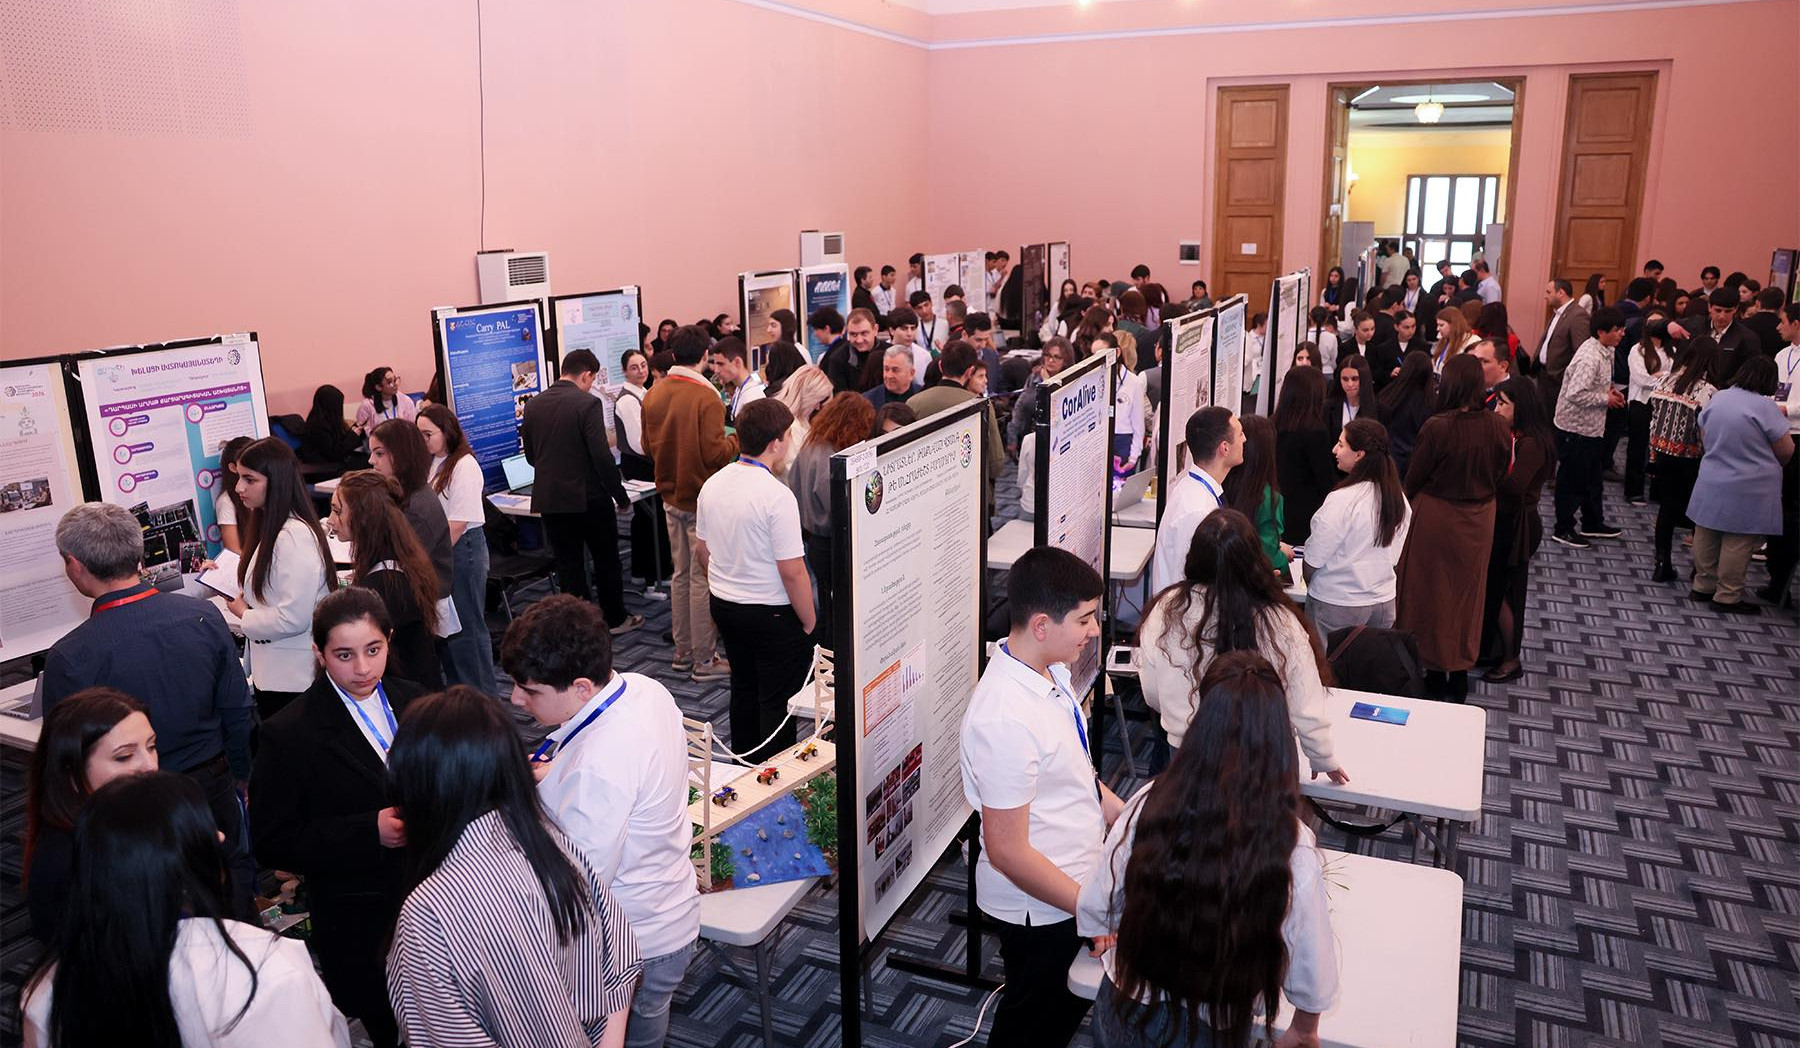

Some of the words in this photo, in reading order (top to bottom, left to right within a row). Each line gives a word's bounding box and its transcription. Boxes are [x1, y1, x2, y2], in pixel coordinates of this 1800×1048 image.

[476, 324, 494, 334] Carry
[496, 320, 510, 330] PAL
[131, 365, 160, 376] ԽԵԼԱՑԻ
[1062, 384, 1096, 420] CorAlive
